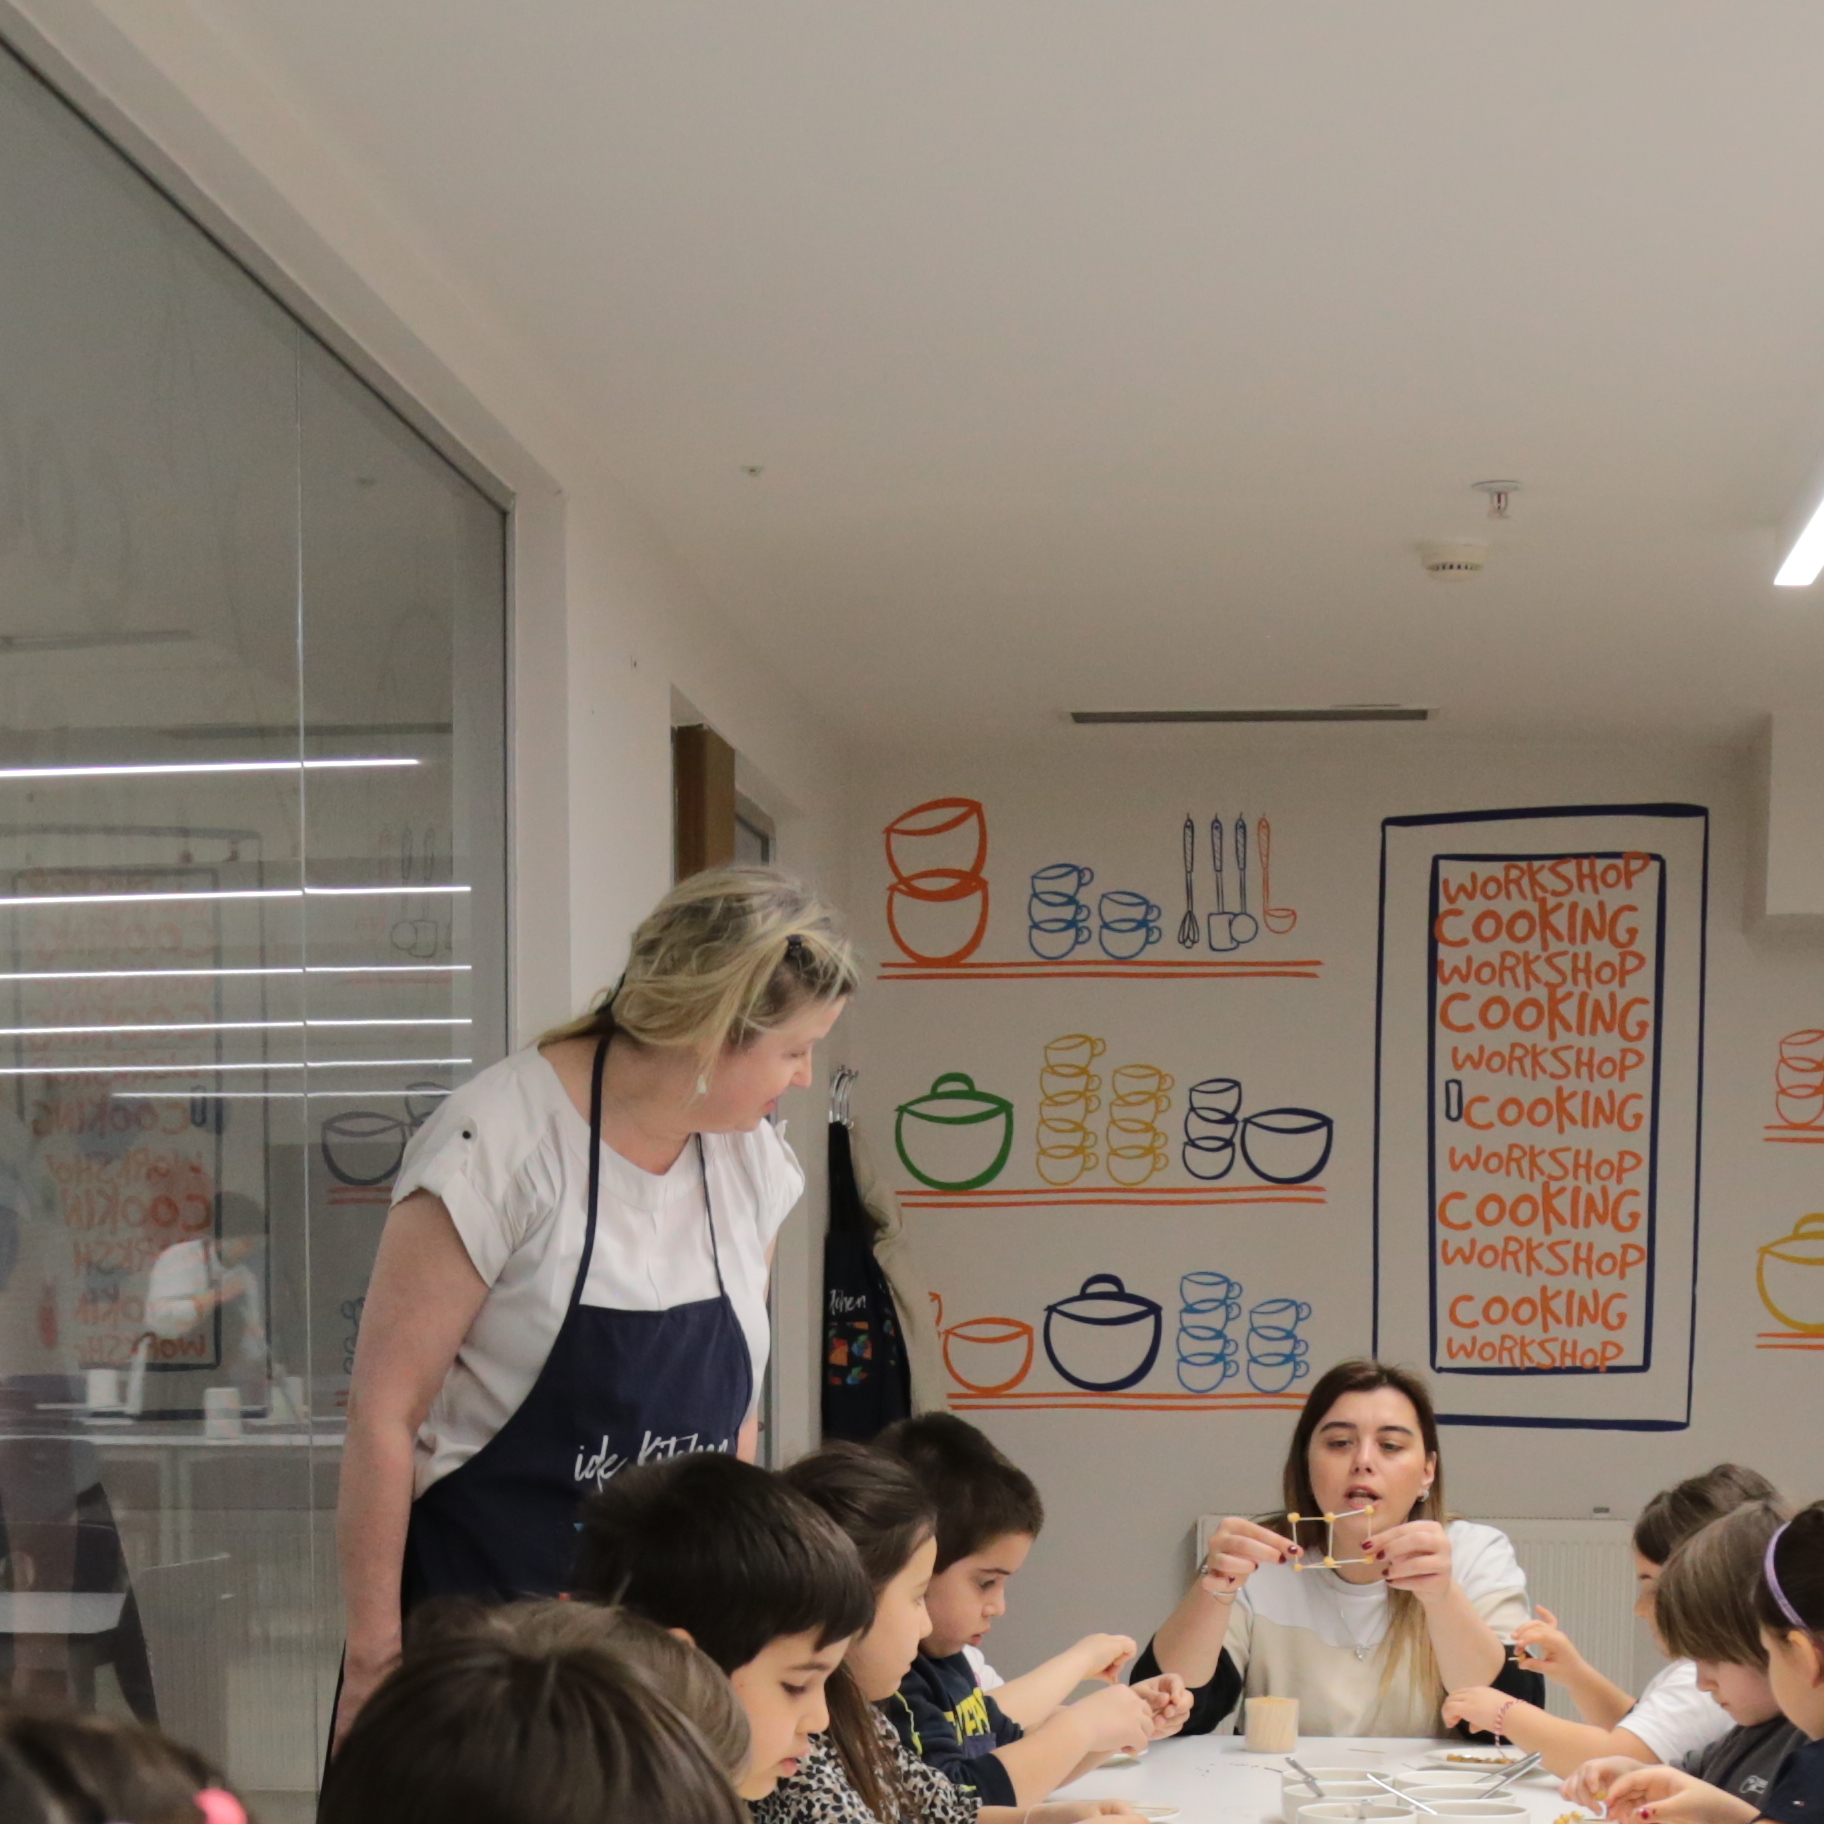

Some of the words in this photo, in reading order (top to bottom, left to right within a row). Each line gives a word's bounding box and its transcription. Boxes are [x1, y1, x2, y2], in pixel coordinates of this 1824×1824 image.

[1442, 851, 1651, 906] WORKSHOP
[1433, 896, 1640, 952] COOKING
[1436, 949, 1647, 991] WORKSHOP
[1439, 982, 1651, 1042] COOKING
[1451, 1042, 1646, 1083] WORKSHOP
[1463, 1086, 1644, 1135] COOKING
[1448, 1143, 1644, 1185] WORKSHOP
[1437, 1180, 1642, 1236] COOKING
[1441, 1236, 1647, 1280] WORKSHOP
[1448, 1284, 1628, 1334] COOKING
[1446, 1334, 1625, 1373] WORKSHOP
[637, 1430, 728, 1466] Kithn
